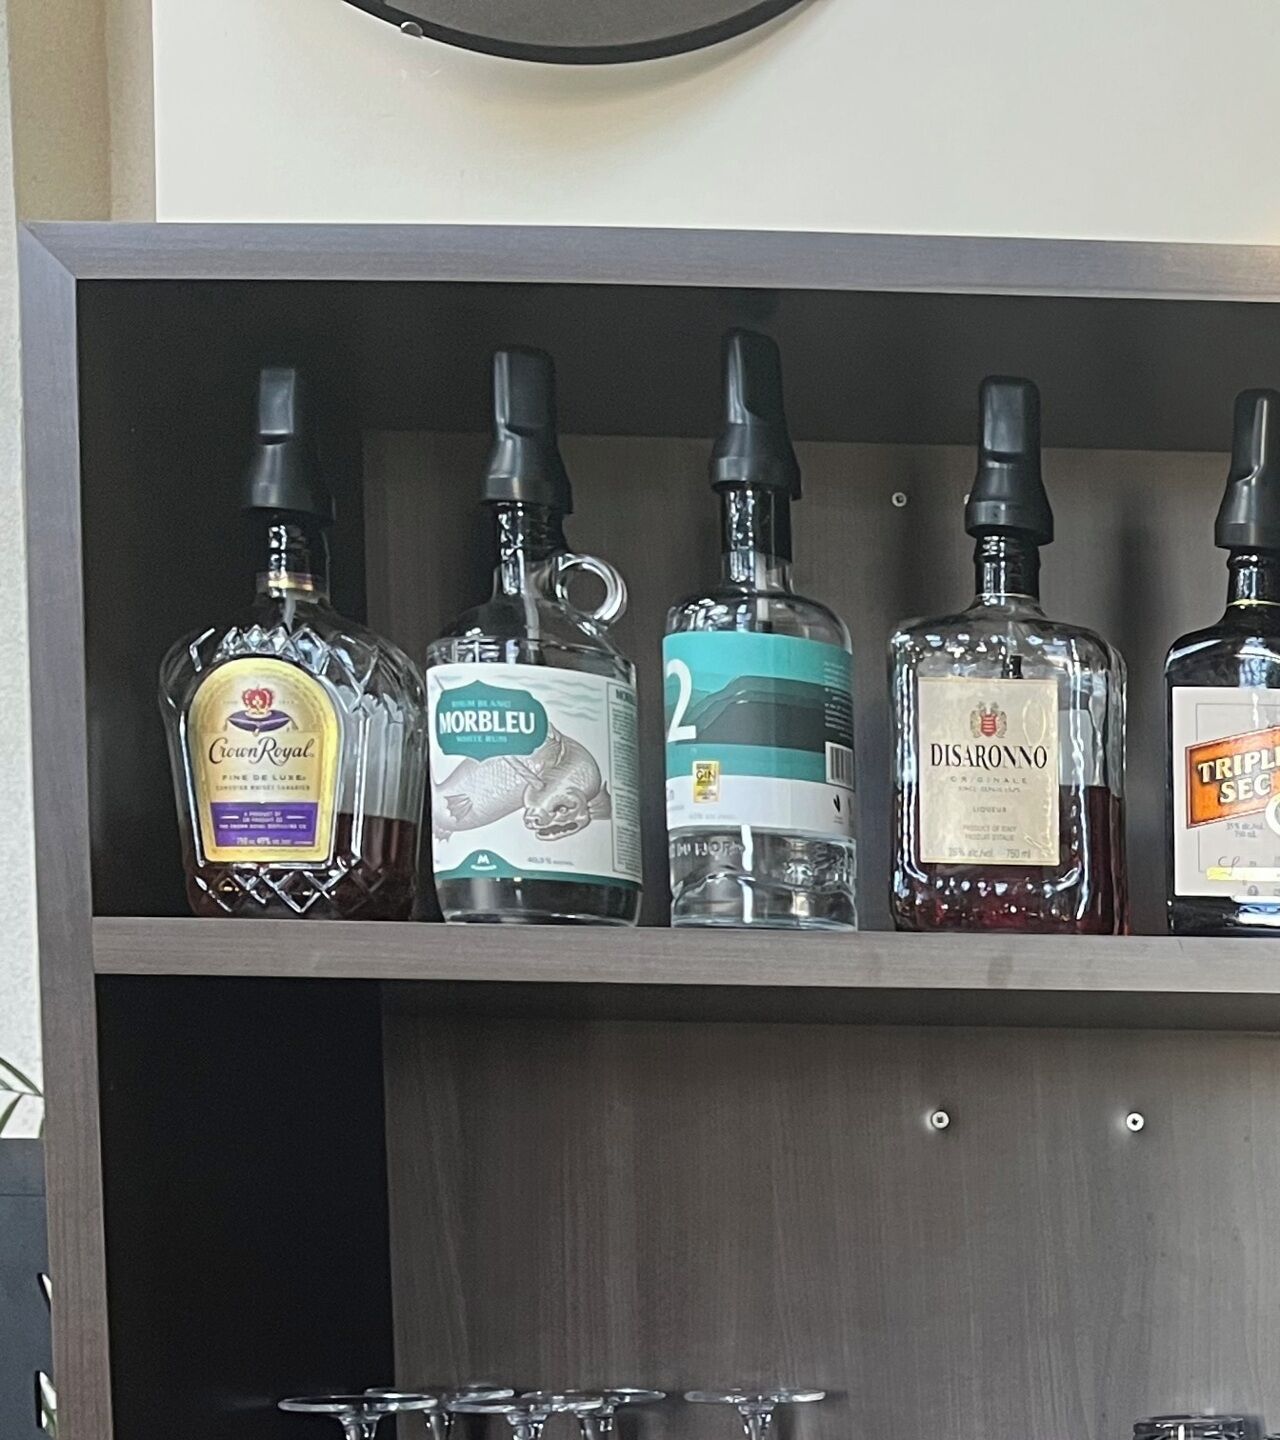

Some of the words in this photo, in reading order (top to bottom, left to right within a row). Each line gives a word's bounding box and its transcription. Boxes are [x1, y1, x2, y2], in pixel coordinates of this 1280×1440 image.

[439, 710, 535, 735] MORBLEU
[208, 737, 258, 765] Crown
[255, 736, 315, 767] Royal
[930, 743, 1048, 771] DISARONNO
[1219, 773, 1273, 804] SEC
